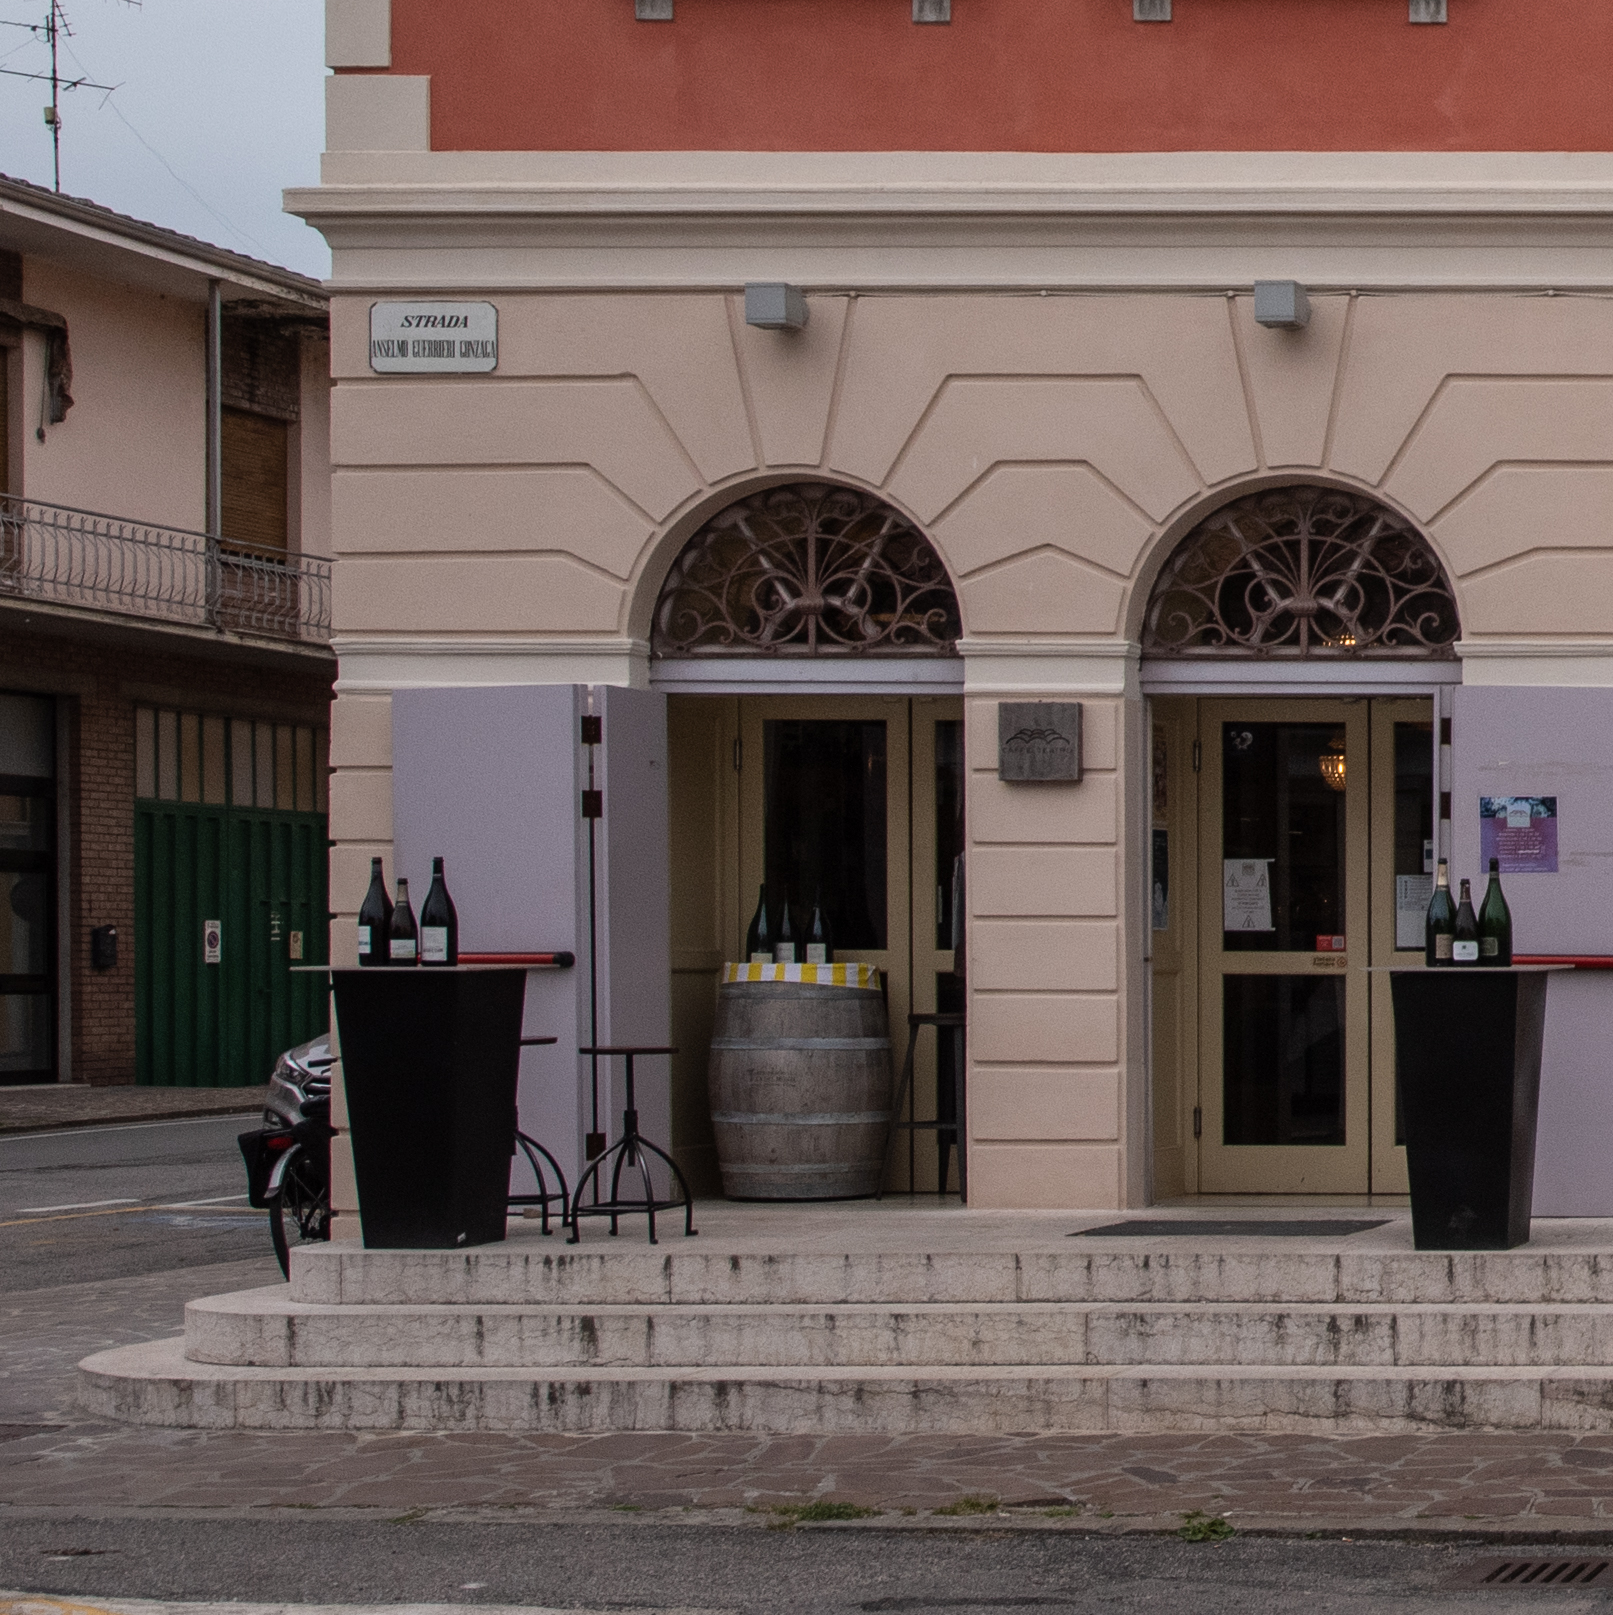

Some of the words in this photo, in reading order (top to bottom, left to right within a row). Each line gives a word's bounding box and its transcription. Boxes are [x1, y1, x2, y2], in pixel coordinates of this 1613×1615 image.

[400, 315, 468, 328] STRADA
[372, 339, 409, 358] ANSELMO
[412, 339, 455, 358] GUERRIERI
[459, 339, 496, 358] GONZAGA
